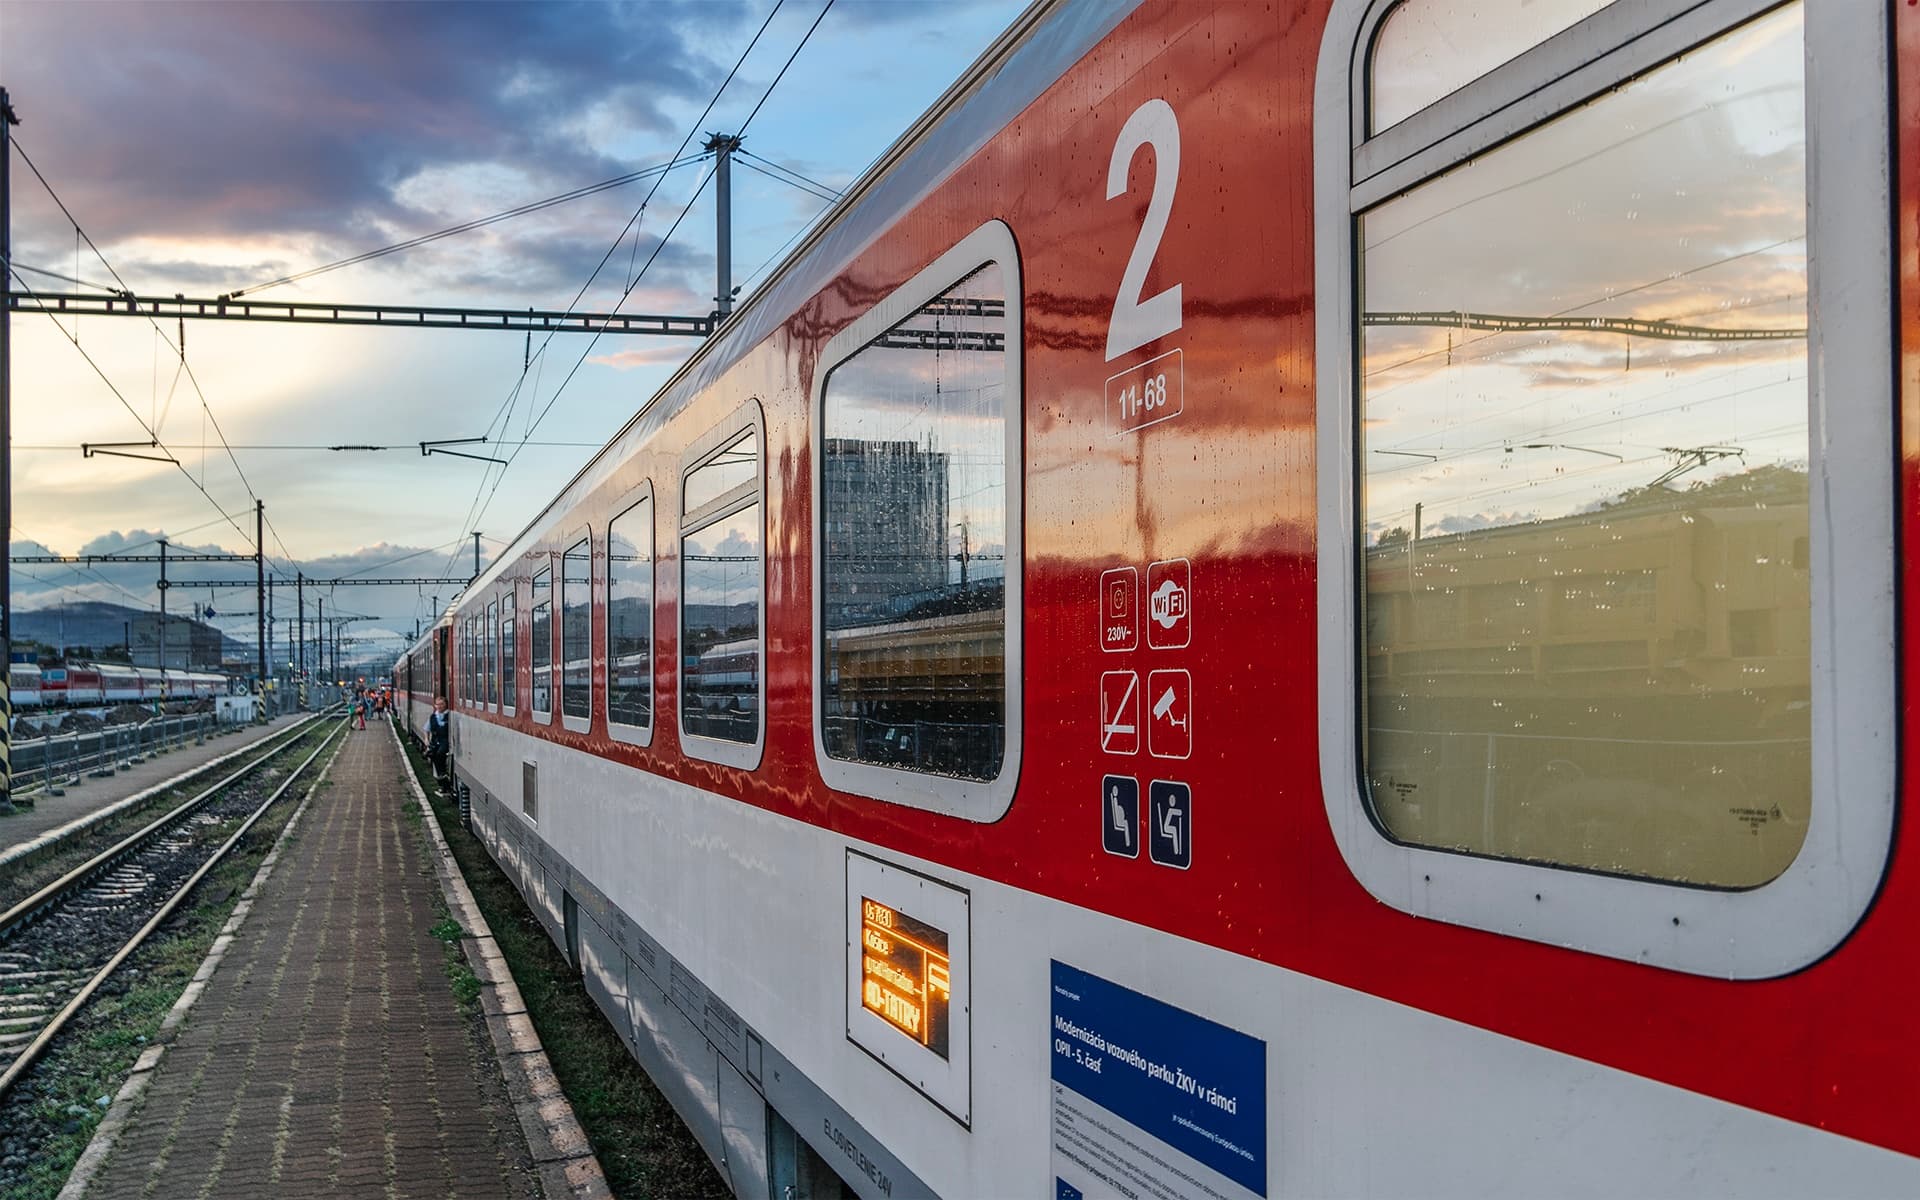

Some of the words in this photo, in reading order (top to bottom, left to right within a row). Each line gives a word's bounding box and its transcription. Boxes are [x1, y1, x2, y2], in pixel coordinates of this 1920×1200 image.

[1105, 98, 1182, 362] 2
[1119, 374, 1166, 420] 11-68
[1055, 1014, 1105, 1051] Modernizácia
[1106, 1041, 1147, 1071] vozového
[1148, 1062, 1175, 1085] parku
[1176, 1067, 1197, 1095] ŽKV
[1197, 1085, 1205, 1099] v
[1206, 1087, 1236, 1115] rámci
[1076, 1048, 1084, 1065] 5.
[1085, 1051, 1102, 1074] časť
